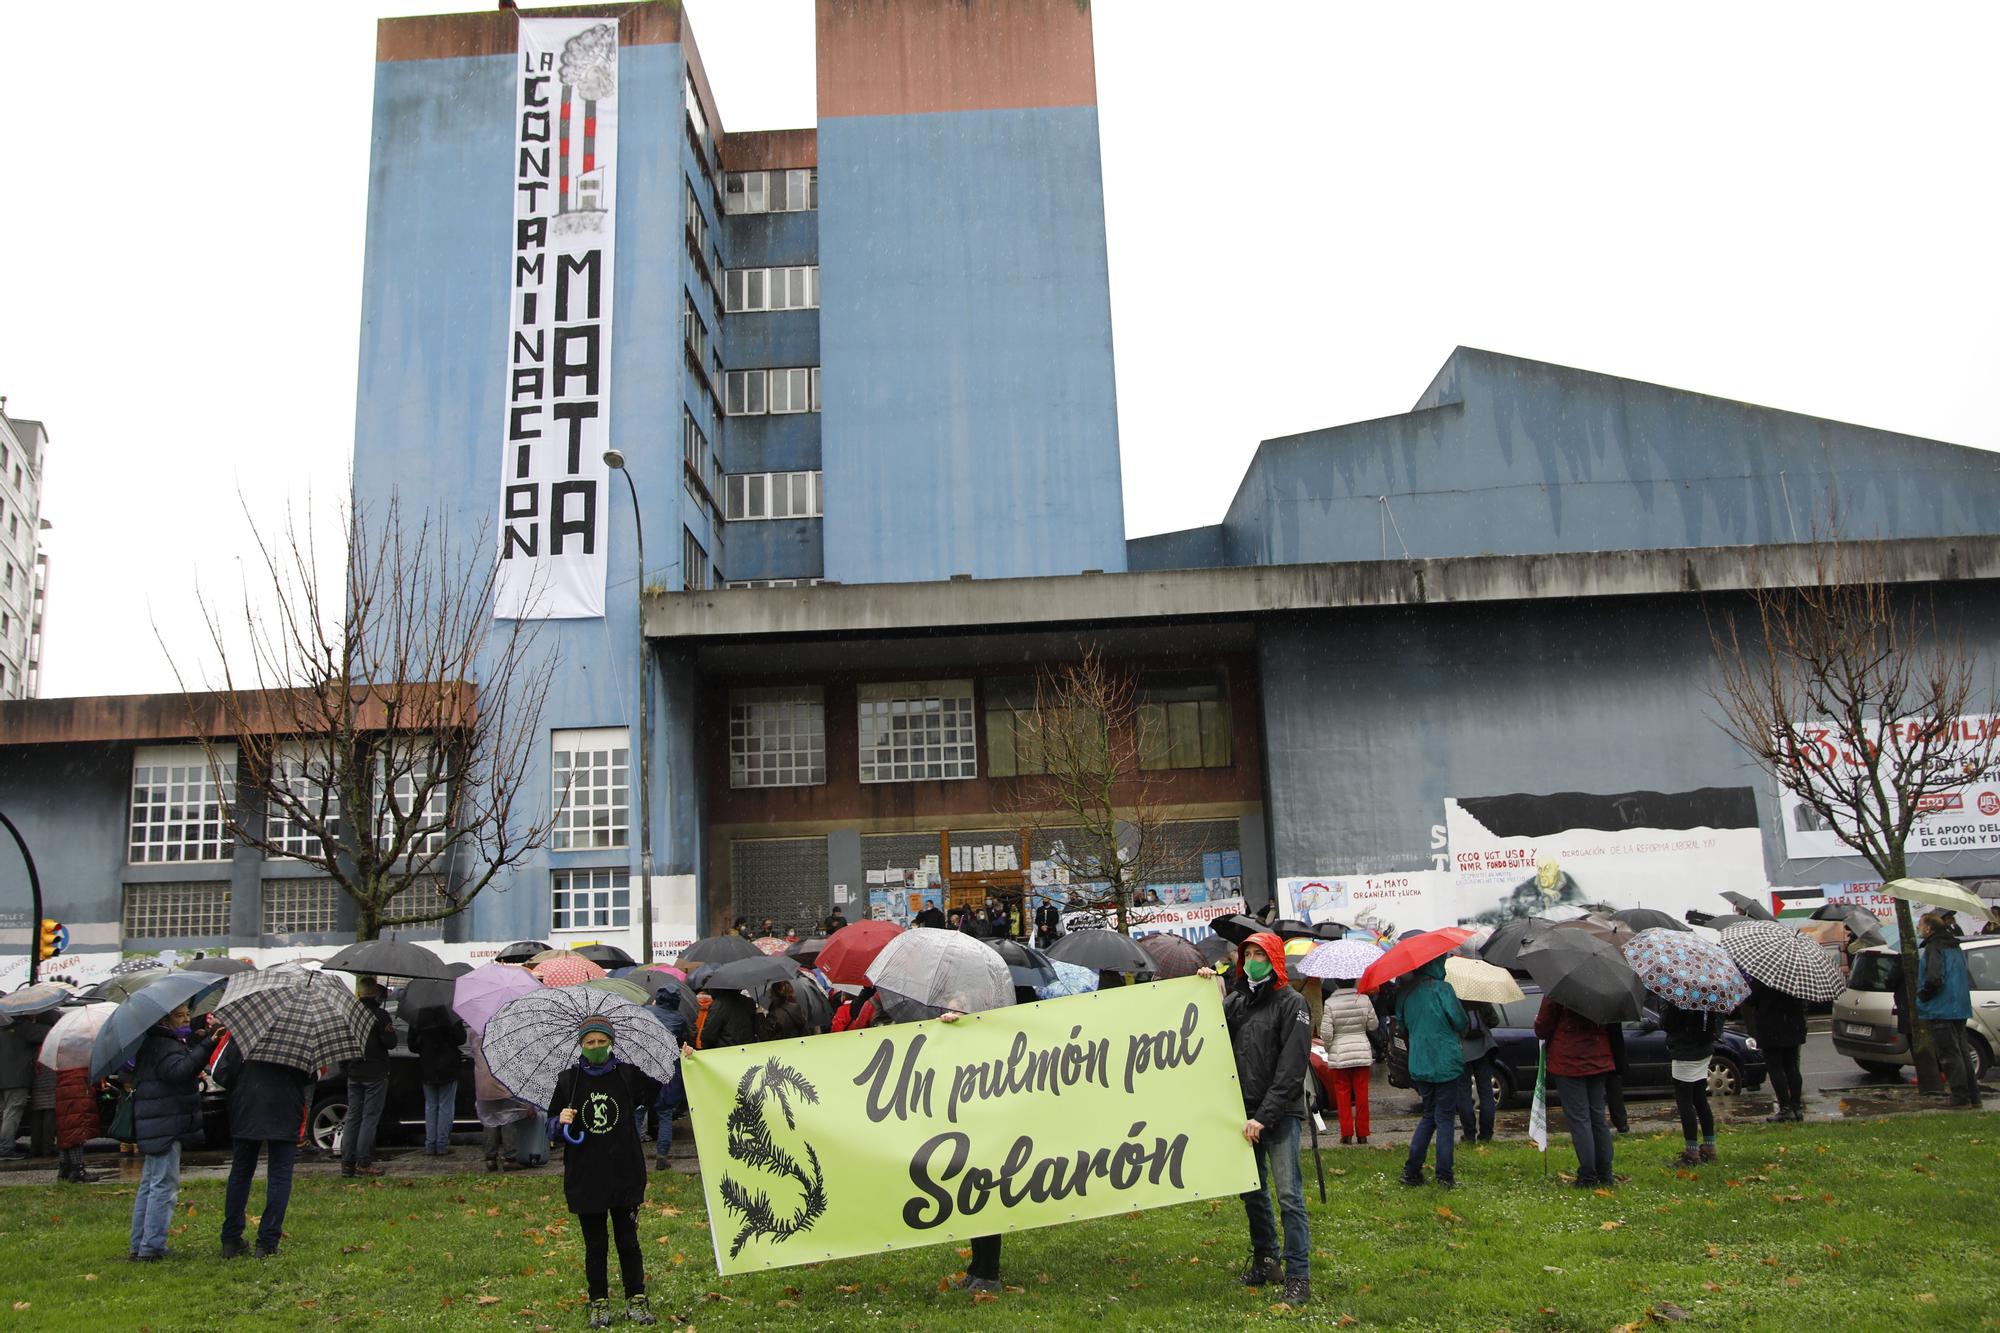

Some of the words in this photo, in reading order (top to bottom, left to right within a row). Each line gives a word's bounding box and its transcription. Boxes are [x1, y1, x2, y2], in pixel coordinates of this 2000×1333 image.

[525, 52, 553, 72] LA
[504, 76, 551, 559] CONTAMINACION
[550, 249, 602, 556] MATA
[1920, 827, 1934, 836] EL
[1937, 825, 1975, 835] APOYO
[1922, 838, 1937, 847] DE
[1940, 834, 1976, 846] GIJÓN
[1979, 835, 1987, 843] Y
[1485, 850, 1501, 860] UGT
[1487, 860, 1507, 870] FONDO
[1508, 858, 1536, 869] BUITRE
[1384, 878, 1409, 889] MAYO
[1402, 889, 1422, 897] LUCHA
[853, 1033, 933, 1123] Un
[946, 1025, 1110, 1123] pulmón
[1124, 1002, 1205, 1094] pal
[901, 1121, 1190, 1230] Solarón
